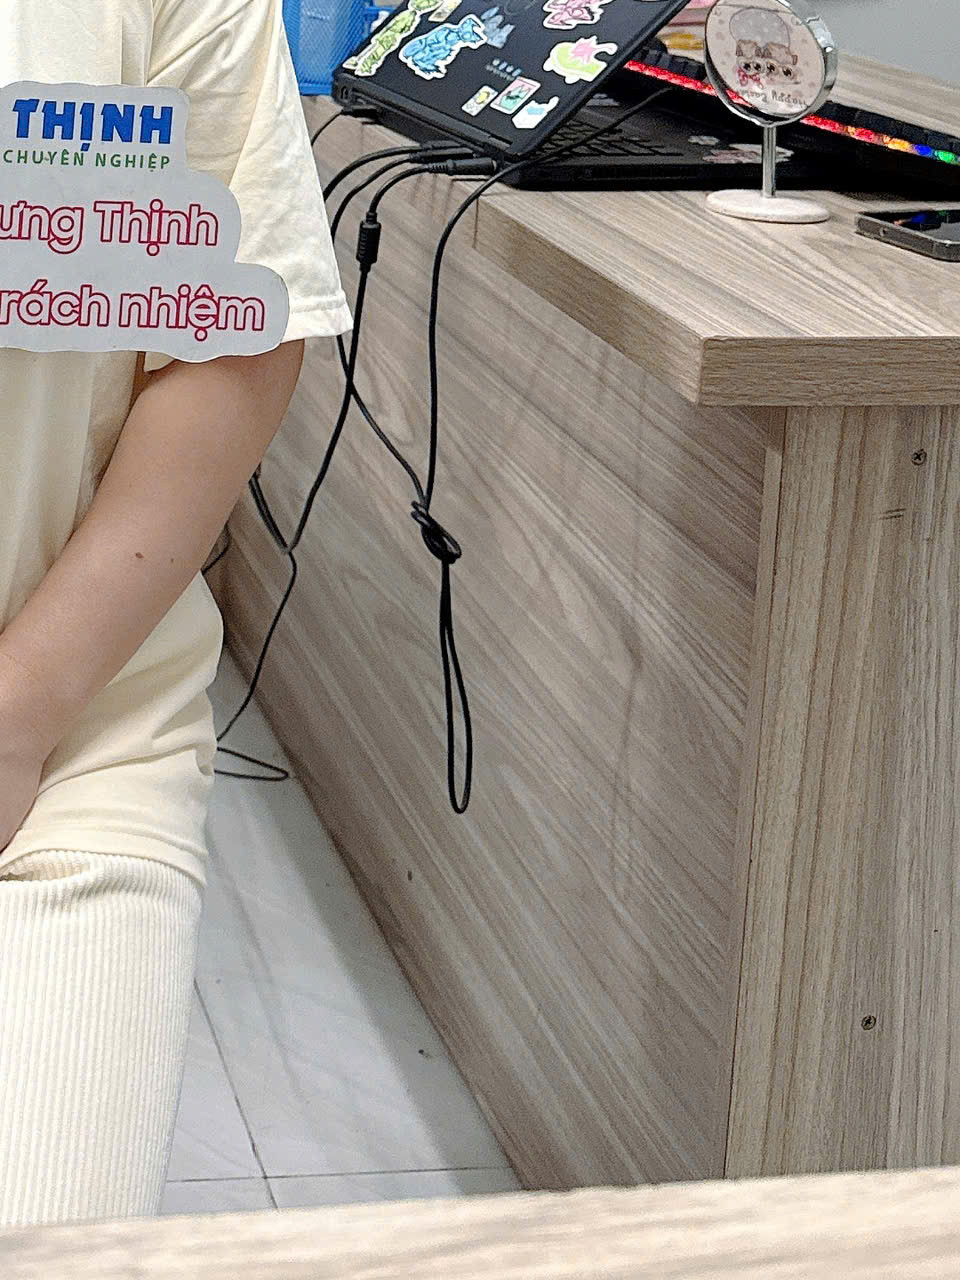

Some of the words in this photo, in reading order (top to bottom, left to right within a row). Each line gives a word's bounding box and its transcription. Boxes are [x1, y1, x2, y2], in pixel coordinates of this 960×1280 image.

[12, 98, 174, 152] THỊNH
[3, 148, 85, 167] CHUYÊN
[95, 152, 171, 172] NGHIỆP
[93, 198, 219, 256] Thịnh
[118, 284, 265, 342] nhiệm
